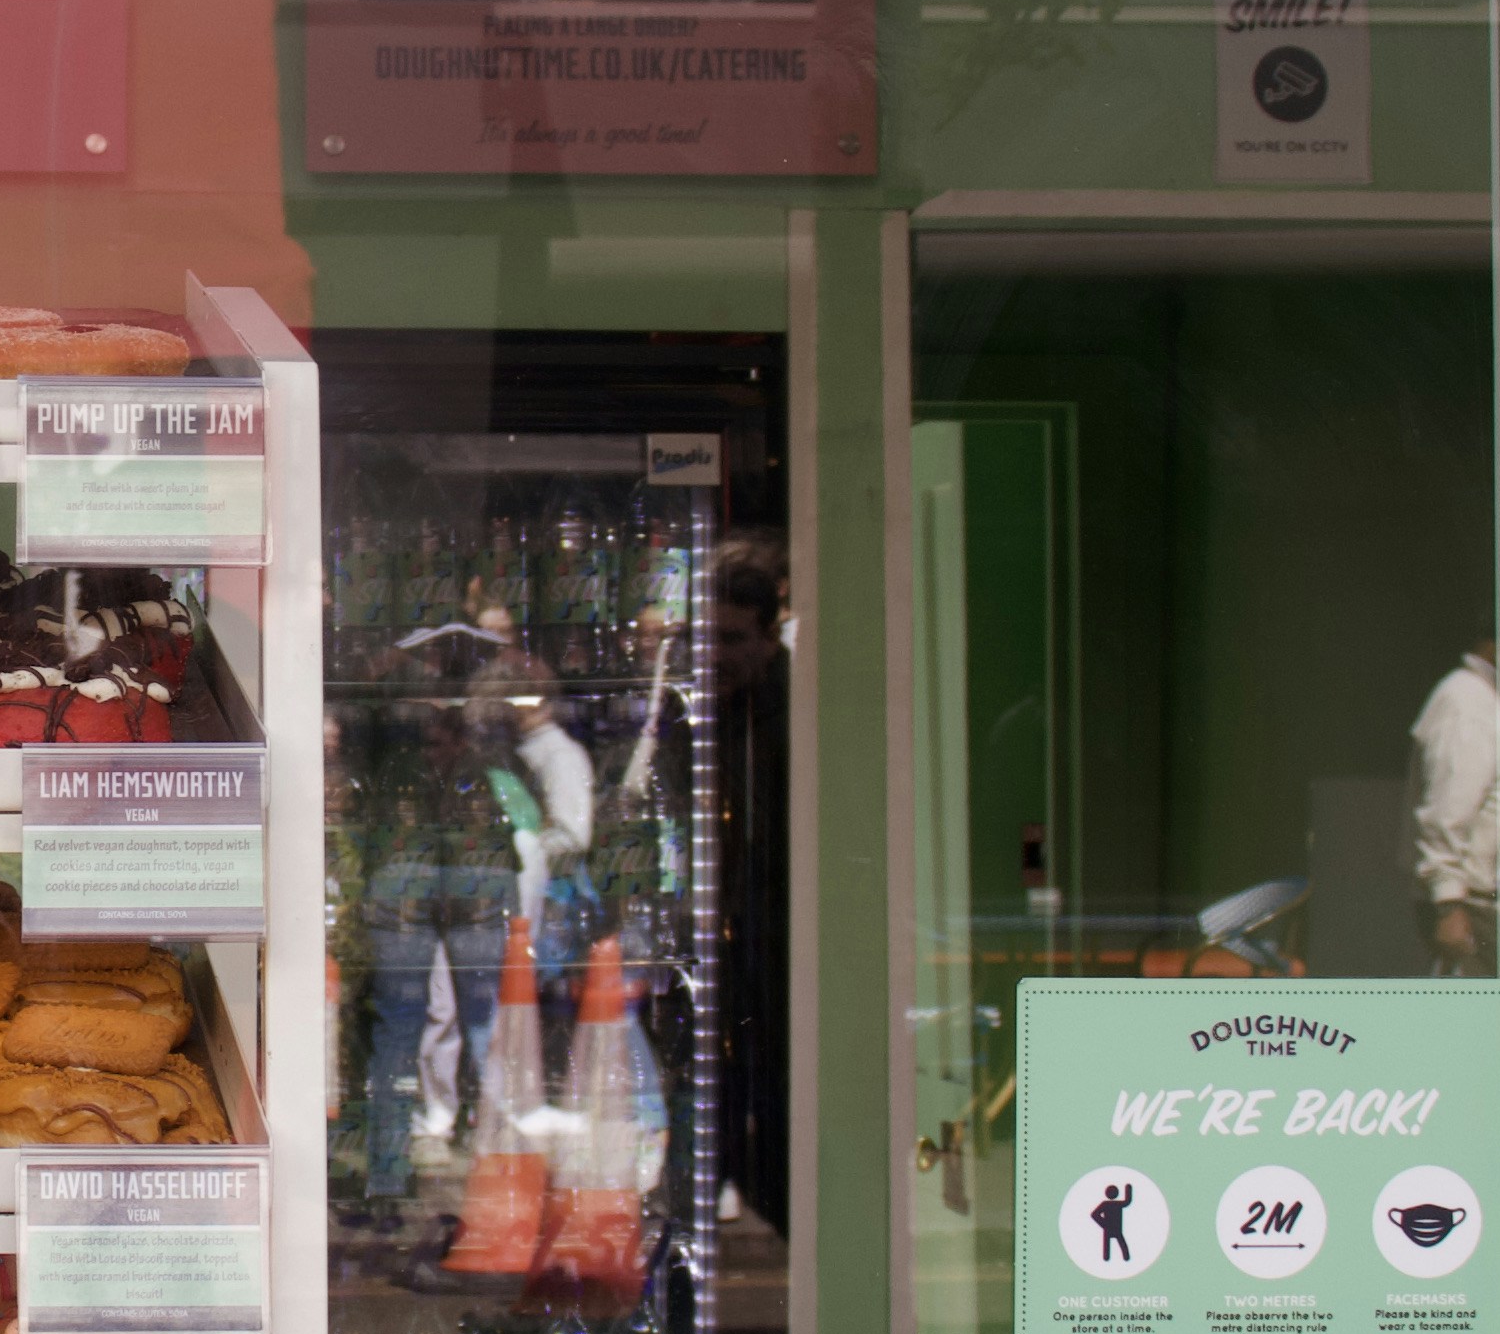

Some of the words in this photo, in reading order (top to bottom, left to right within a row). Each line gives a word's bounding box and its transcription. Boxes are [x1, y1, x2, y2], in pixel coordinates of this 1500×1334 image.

[1286, 141, 1307, 154] ON
[1310, 141, 1349, 154] CCTV
[36, 402, 105, 435] PUMP
[113, 402, 145, 435] UP
[153, 402, 197, 435] THE
[205, 403, 254, 435] JAM
[129, 437, 160, 451] VEGAN
[40, 771, 88, 798] LIAM
[97, 771, 243, 798] HEMSWORTHY
[124, 808, 158, 821] VEGAN
[1189, 1014, 1358, 1056] DOUGHNUT
[1246, 1039, 1298, 1057] TIME
[1110, 1082, 1277, 1137] WE'RE
[1283, 1087, 1440, 1137] BACK!
[40, 1172, 102, 1199] DAVID
[111, 1171, 246, 1199] HASSELHOFF
[126, 1208, 160, 1222] VEGAN
[1239, 1200, 1304, 1235] 2M
[1057, 1295, 1087, 1308] ONE
[1090, 1295, 1168, 1307] CUSTOMER
[1223, 1294, 1258, 1307] TWO
[1262, 1294, 1316, 1307] METRES
[1385, 1292, 1466, 1305] FACEMASKS
[1052, 1310, 1075, 1321] One
[1078, 1313, 1116, 1322] person
[1119, 1311, 1152, 1321] inside
[1155, 1310, 1173, 1321] the
[1205, 1310, 1241, 1321] Please
[1244, 1310, 1288, 1320] observe
[1291, 1310, 1309, 1320] the
[1311, 1310, 1333, 1320] two
[1374, 1308, 1410, 1319] Please
[1412, 1309, 1427, 1319] be
[1430, 1309, 1453, 1318] kind
[1455, 1309, 1476, 1318] and
[1071, 1323, 1099, 1333] store
[1101, 1323, 1113, 1333] at
[1115, 1325, 1123, 1333] a
[1126, 1323, 1155, 1333] time.
[1210, 1323, 1243, 1332] metre
[1245, 1323, 1303, 1334] distancing
[1306, 1322, 1327, 1332] rule
[1378, 1323, 1406, 1331] wear
[1408, 1323, 1415, 1331] a
[1418, 1320, 1473, 1331] facemask.
